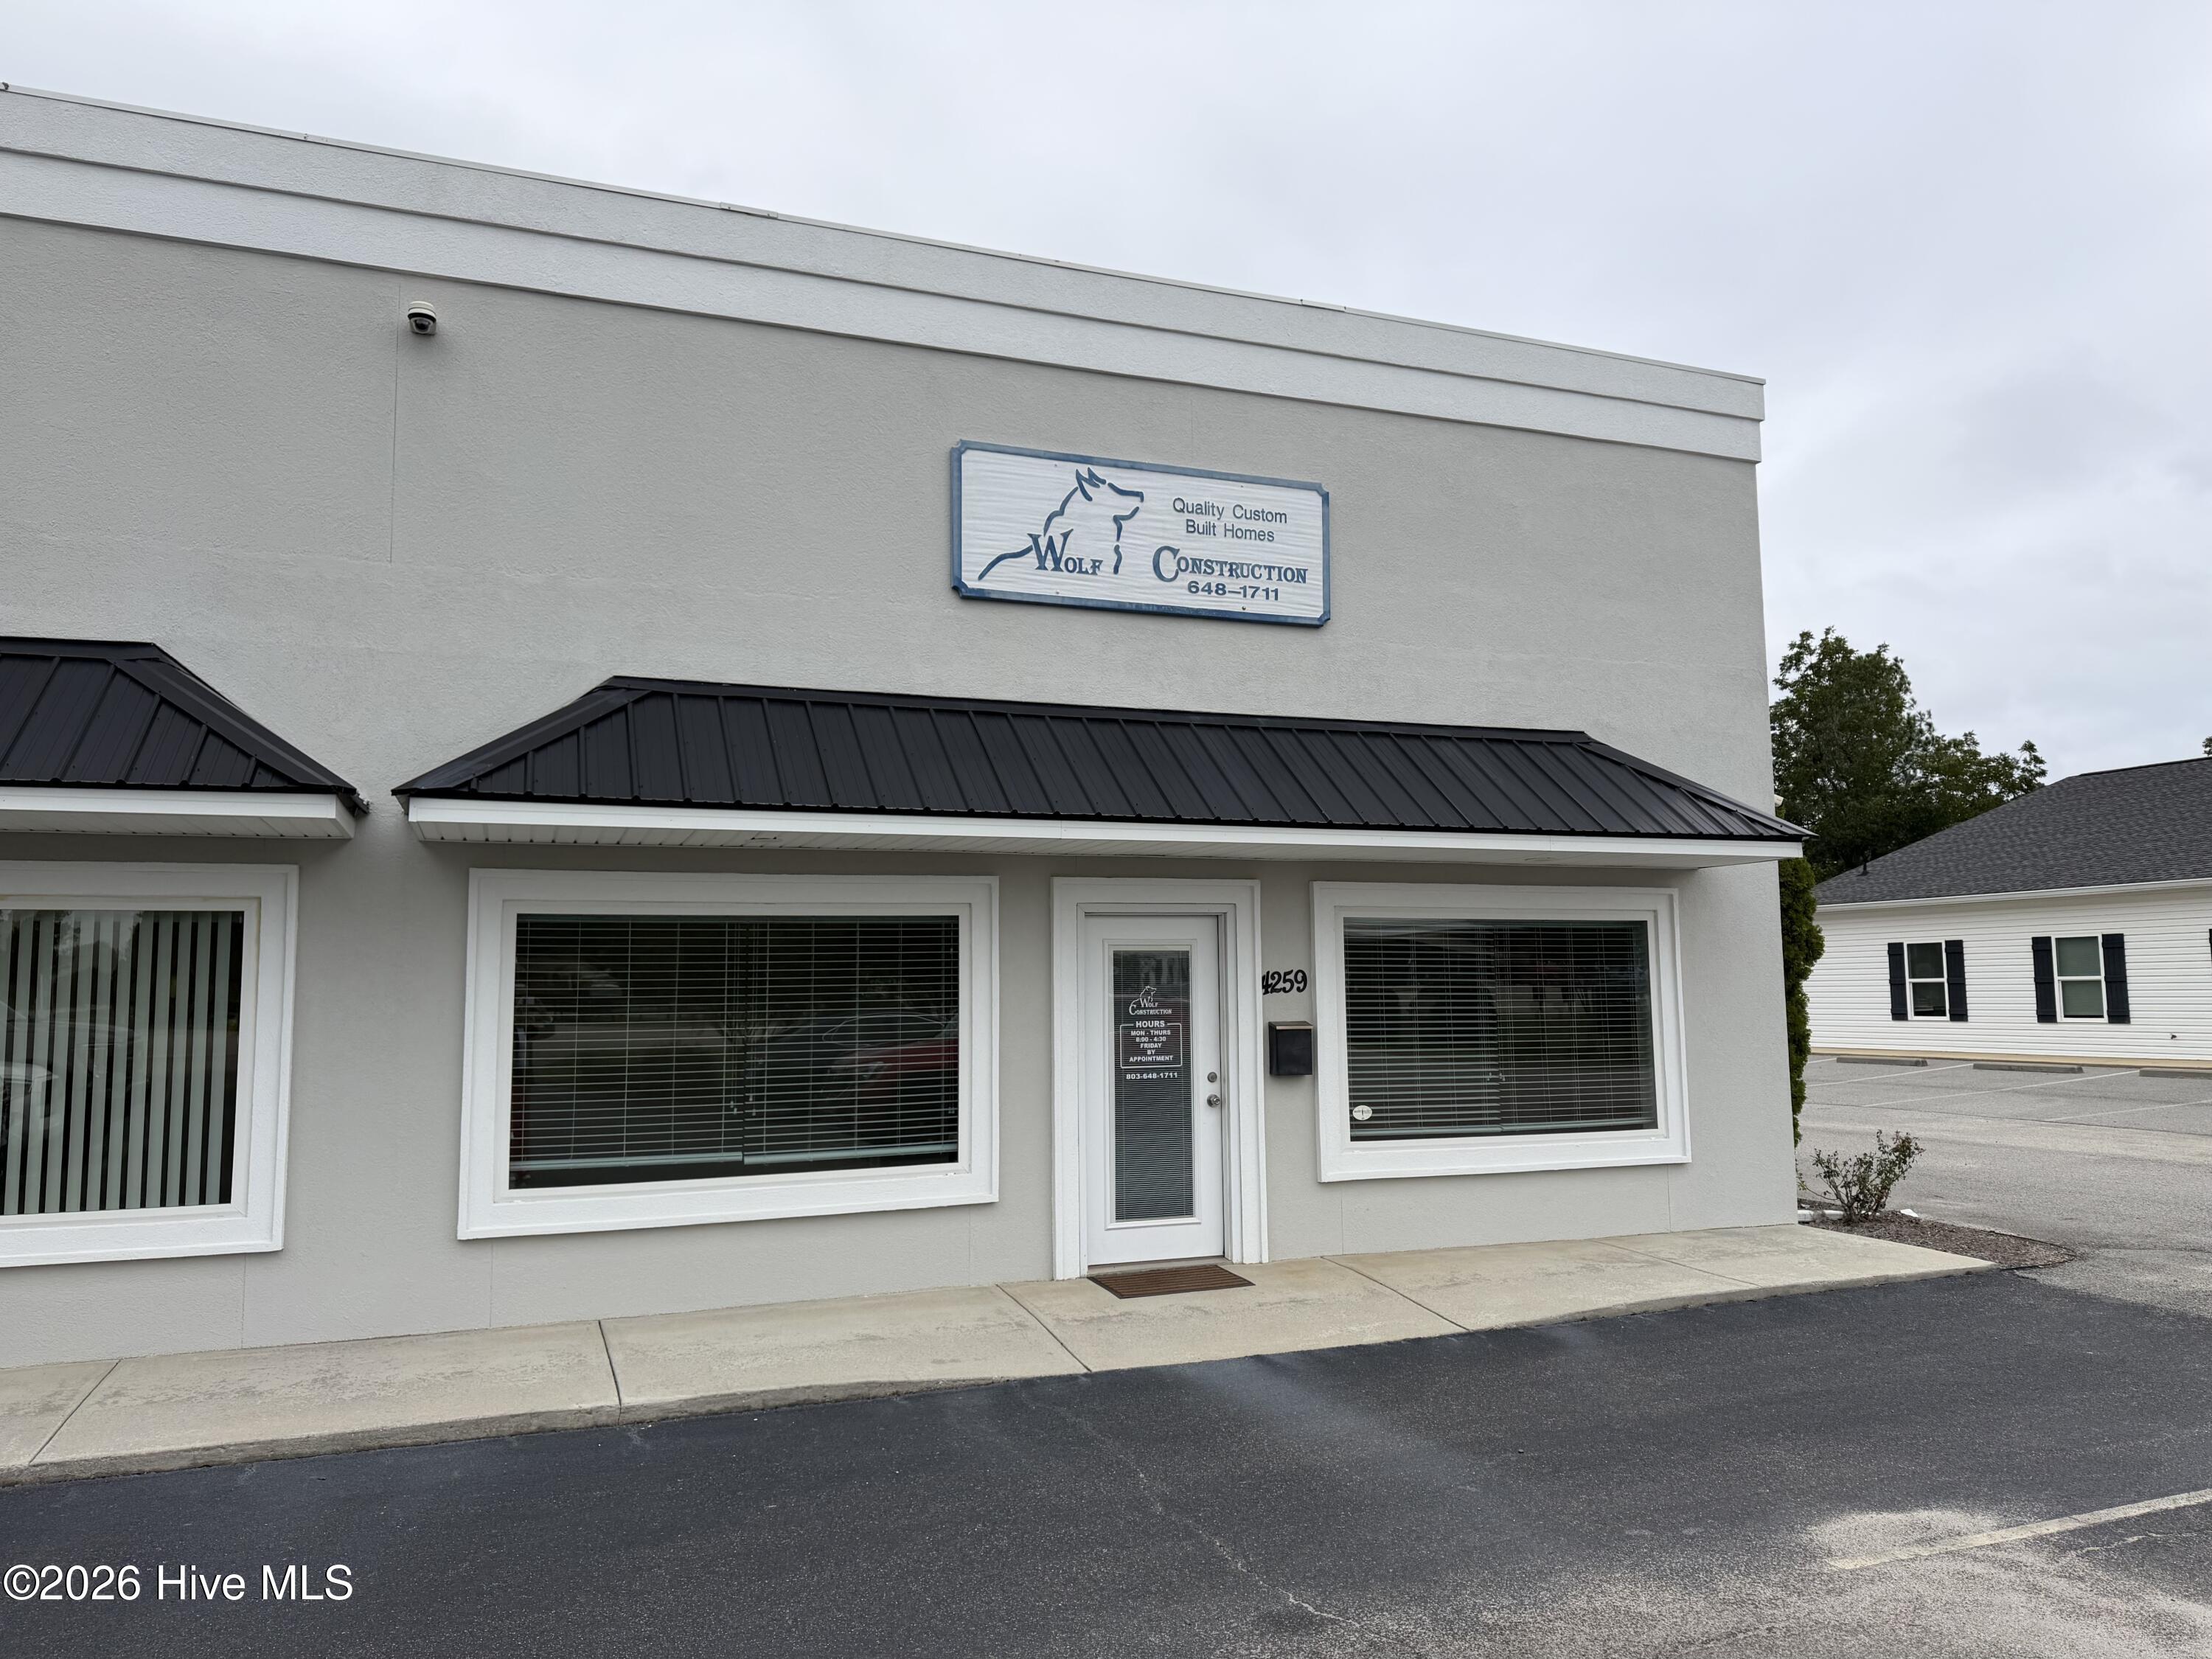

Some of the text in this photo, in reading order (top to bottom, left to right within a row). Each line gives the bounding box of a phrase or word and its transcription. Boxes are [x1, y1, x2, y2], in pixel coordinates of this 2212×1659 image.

[1172, 498, 1288, 524] Quality Custom
[1186, 518, 1276, 543] Built Homes
[1026, 528, 1309, 584] WOLF CONSTRUCTION
[1186, 580, 1280, 601] 648-1711
[1262, 969, 1308, 995] 4259
[1129, 1004, 1172, 1015] CONSTRUCTION
[1139, 996, 1158, 1007] WOLF
